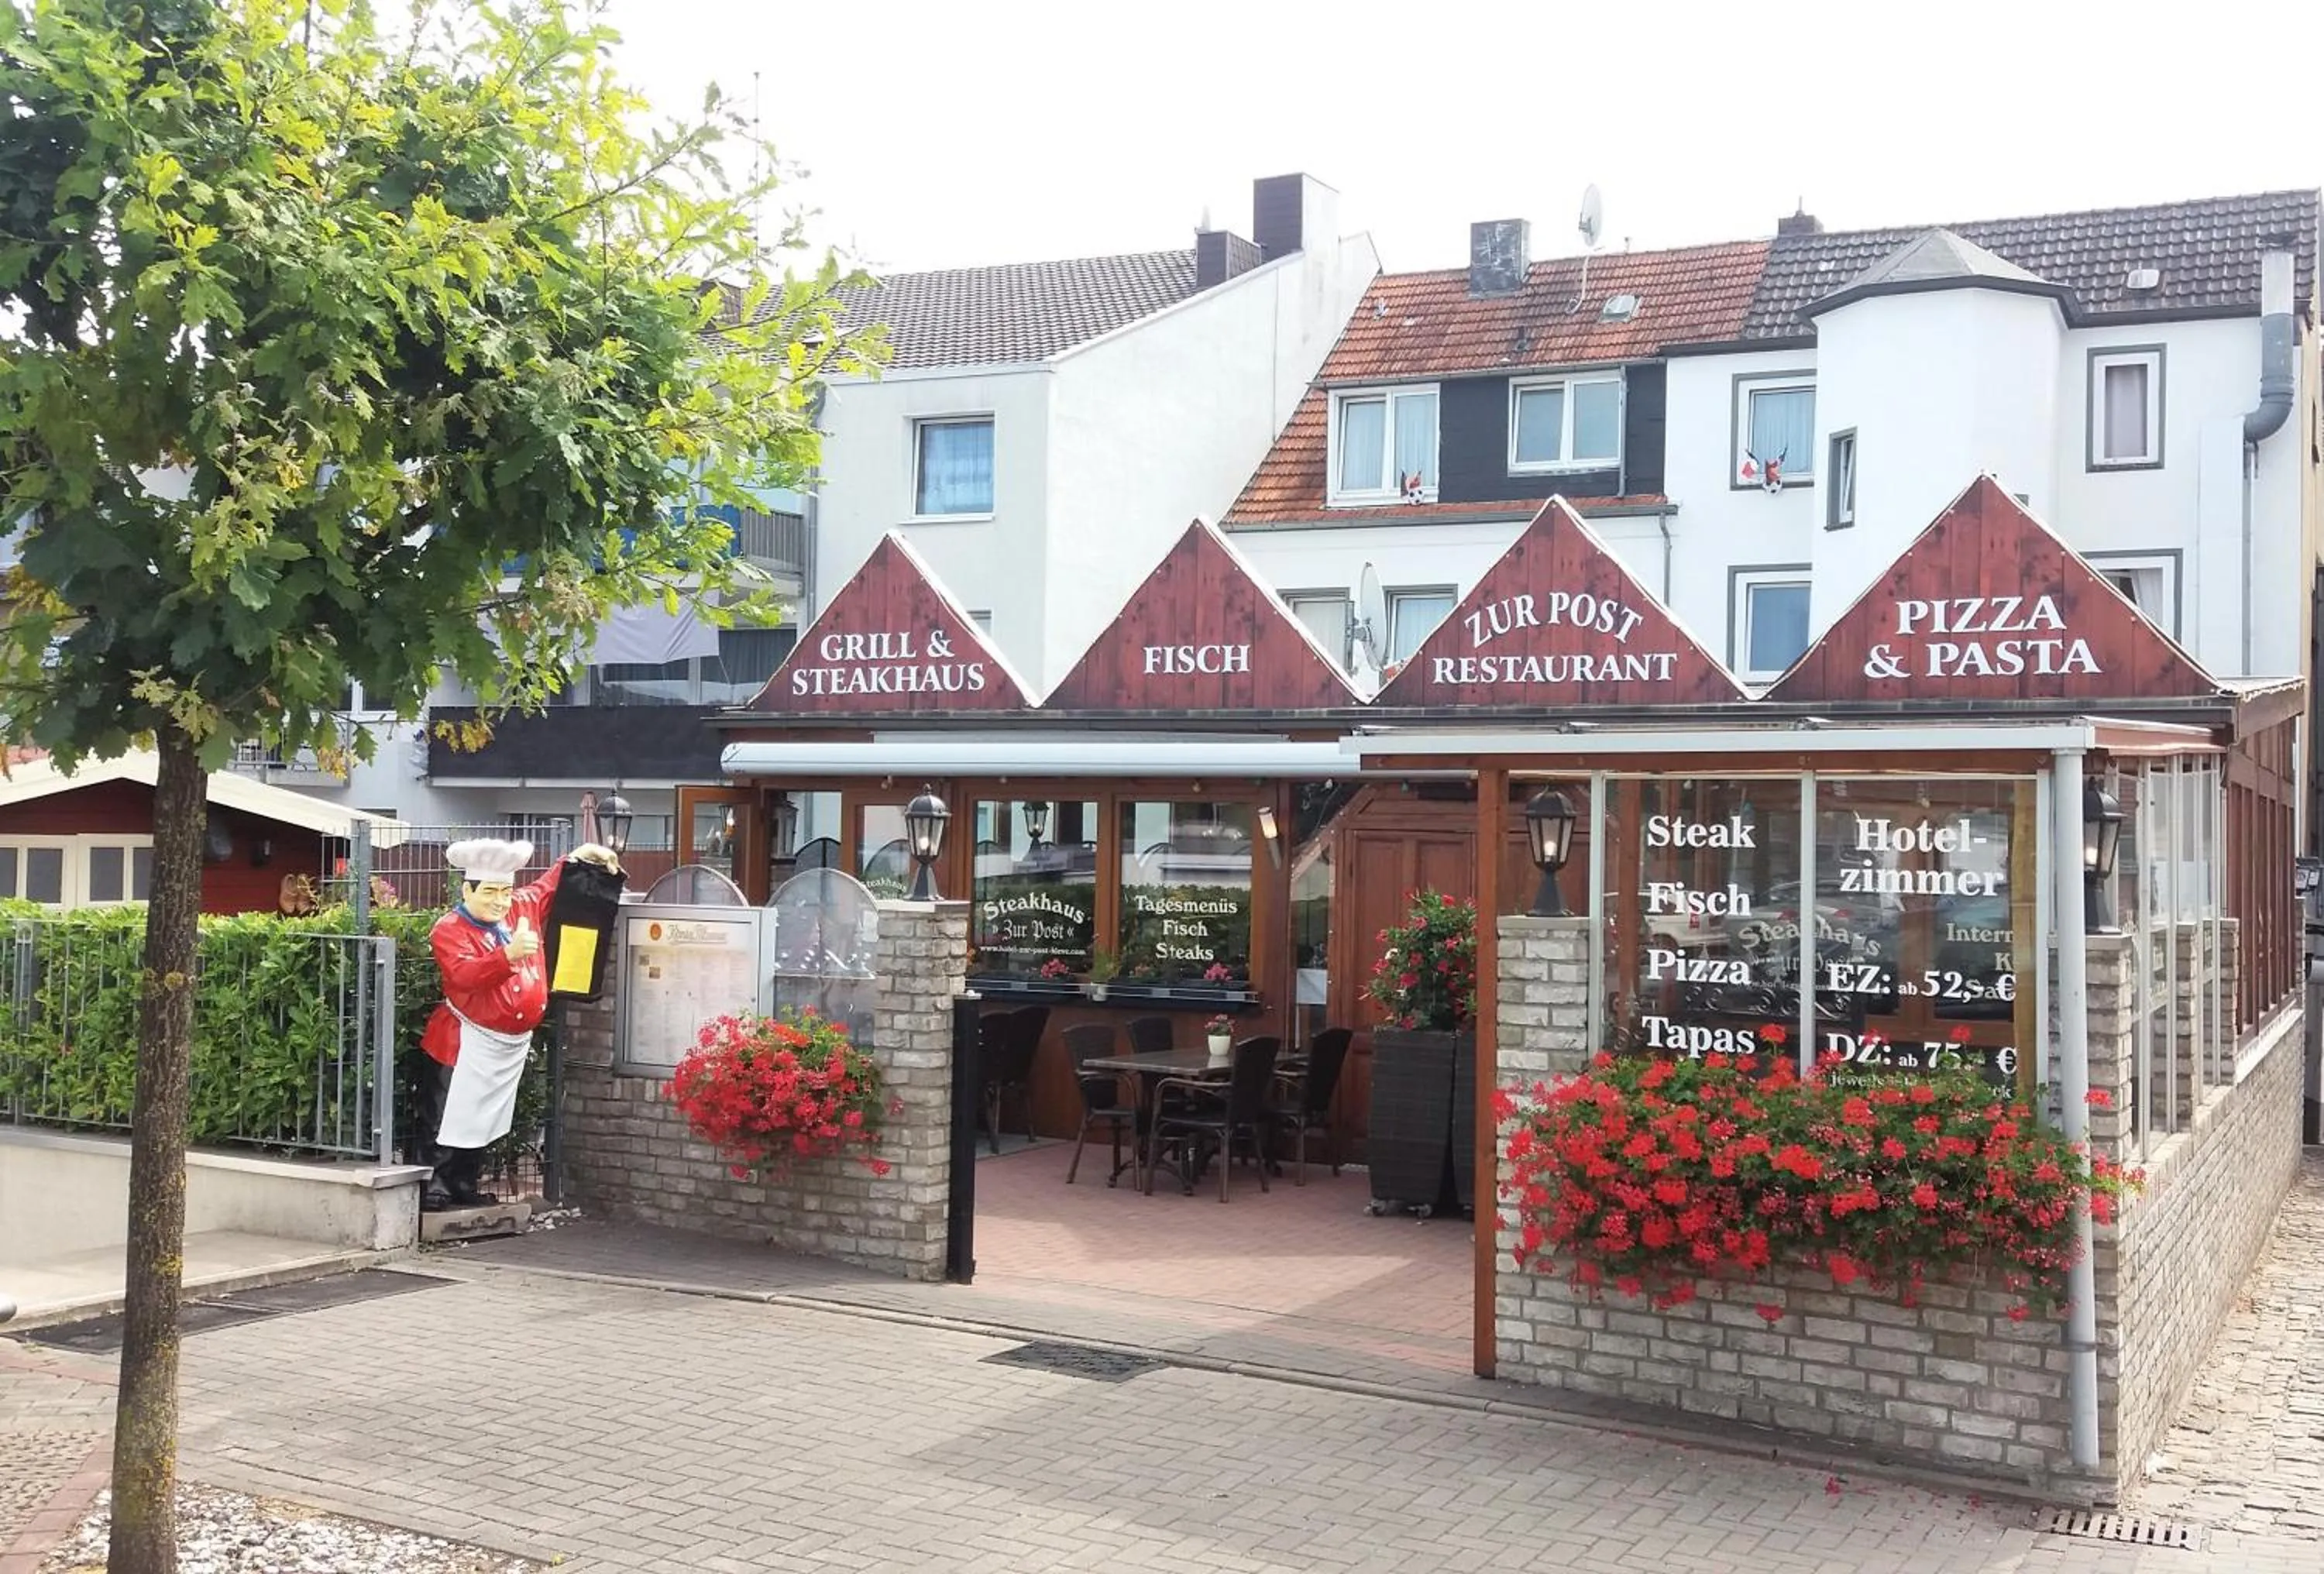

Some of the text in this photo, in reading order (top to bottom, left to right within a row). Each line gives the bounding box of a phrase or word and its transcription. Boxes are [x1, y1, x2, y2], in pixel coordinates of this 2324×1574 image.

[1463, 591, 1644, 649] ZUR POST
[1896, 595, 2067, 636] PIZZA
[820, 629, 955, 662] GRILL &
[1142, 644, 1251, 675] FISCH
[1863, 637, 2103, 679] & PASTA
[792, 662, 986, 696] STEAKHAUS
[1432, 651, 1679, 686] RESTAURANT
[1646, 815, 1756, 850] Steak
[1855, 818, 1987, 853] Hotel-
[1838, 859, 2005, 897] zimmer
[983, 892, 1085, 925] Steakhaus
[1133, 895, 1239, 915] Tagesmenüs
[1646, 881, 1752, 917] Fisch
[1002, 919, 1029, 941] Zur
[1031, 919, 1064, 943] Post
[1163, 919, 1209, 937] Fisch
[1154, 943, 1215, 961] Steaks
[1646, 948, 1752, 985] Pizza
[1827, 963, 1892, 995] EZ:
[1897, 981, 1918, 996] ab
[1995, 974, 2017, 1002] €
[1641, 1016, 1757, 1060] Tapas
[1826, 1033, 1892, 1066] DZ:
[1898, 1053, 1919, 1067] ab
[1995, 1046, 2018, 1075] €
